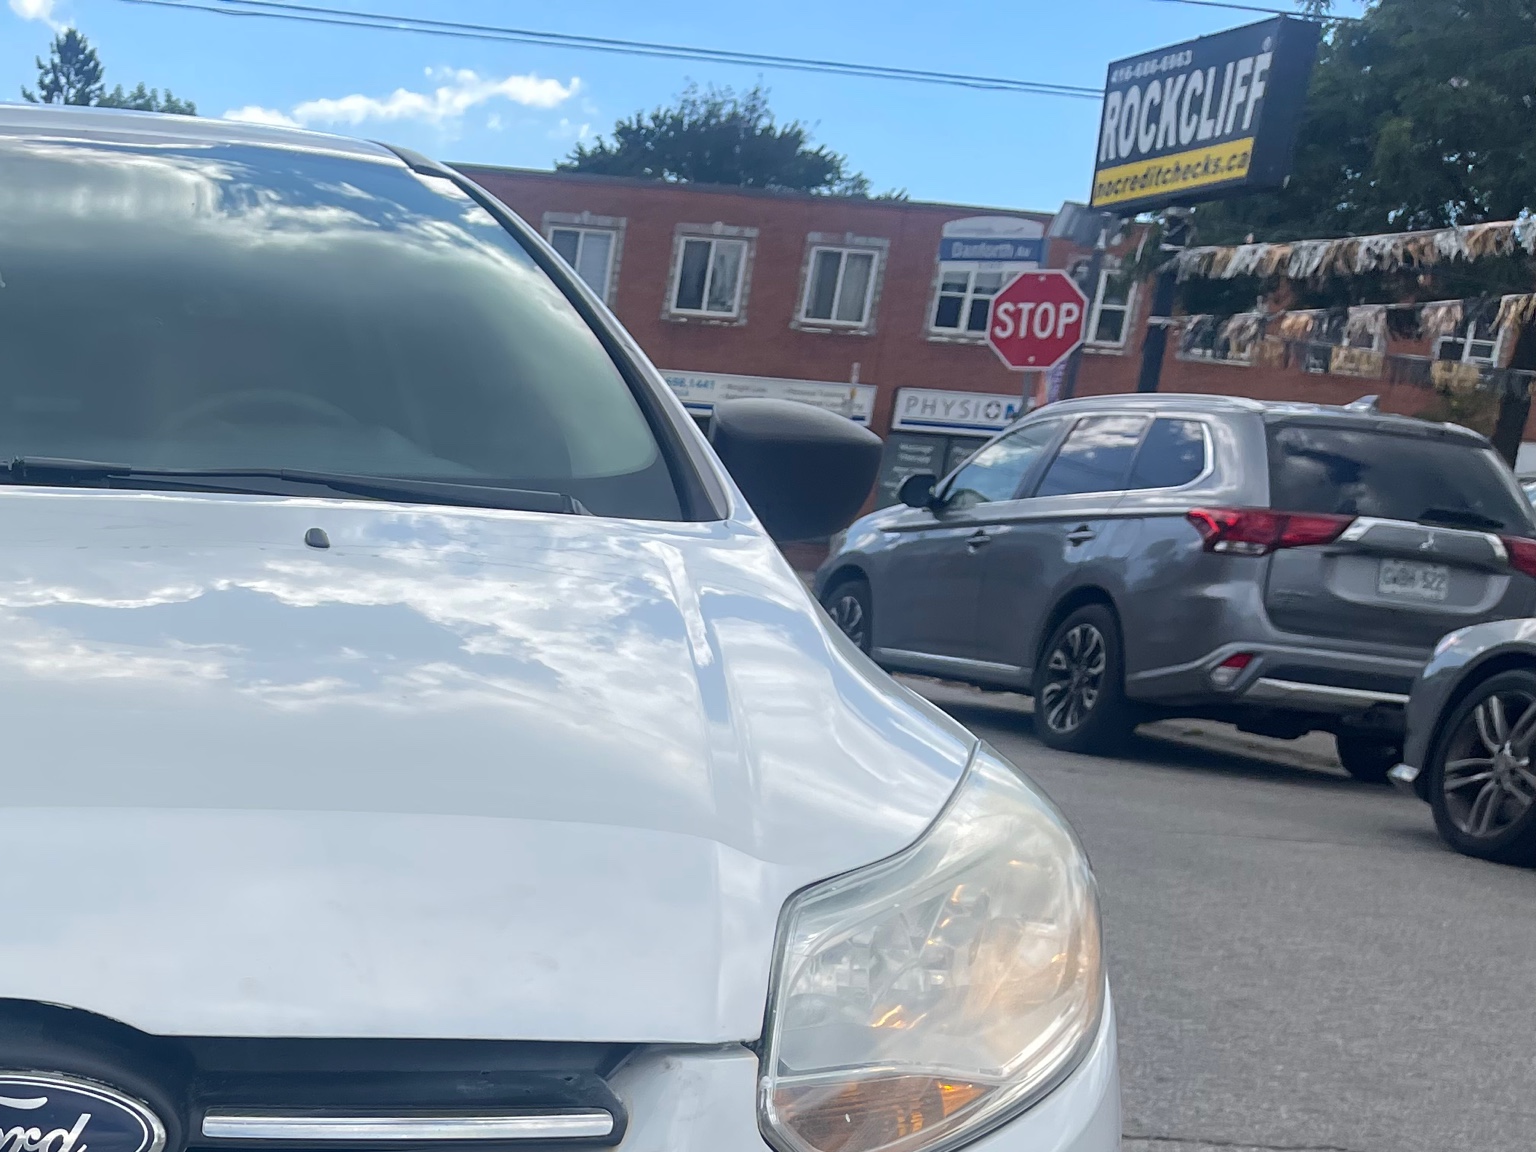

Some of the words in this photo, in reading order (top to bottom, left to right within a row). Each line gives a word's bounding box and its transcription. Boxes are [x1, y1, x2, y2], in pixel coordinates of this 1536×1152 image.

[1099, 52, 1273, 162] ROCKCLIFF
[1095, 151, 1249, 198] nocreditchecks.ca
[993, 301, 1080, 339] STOP
